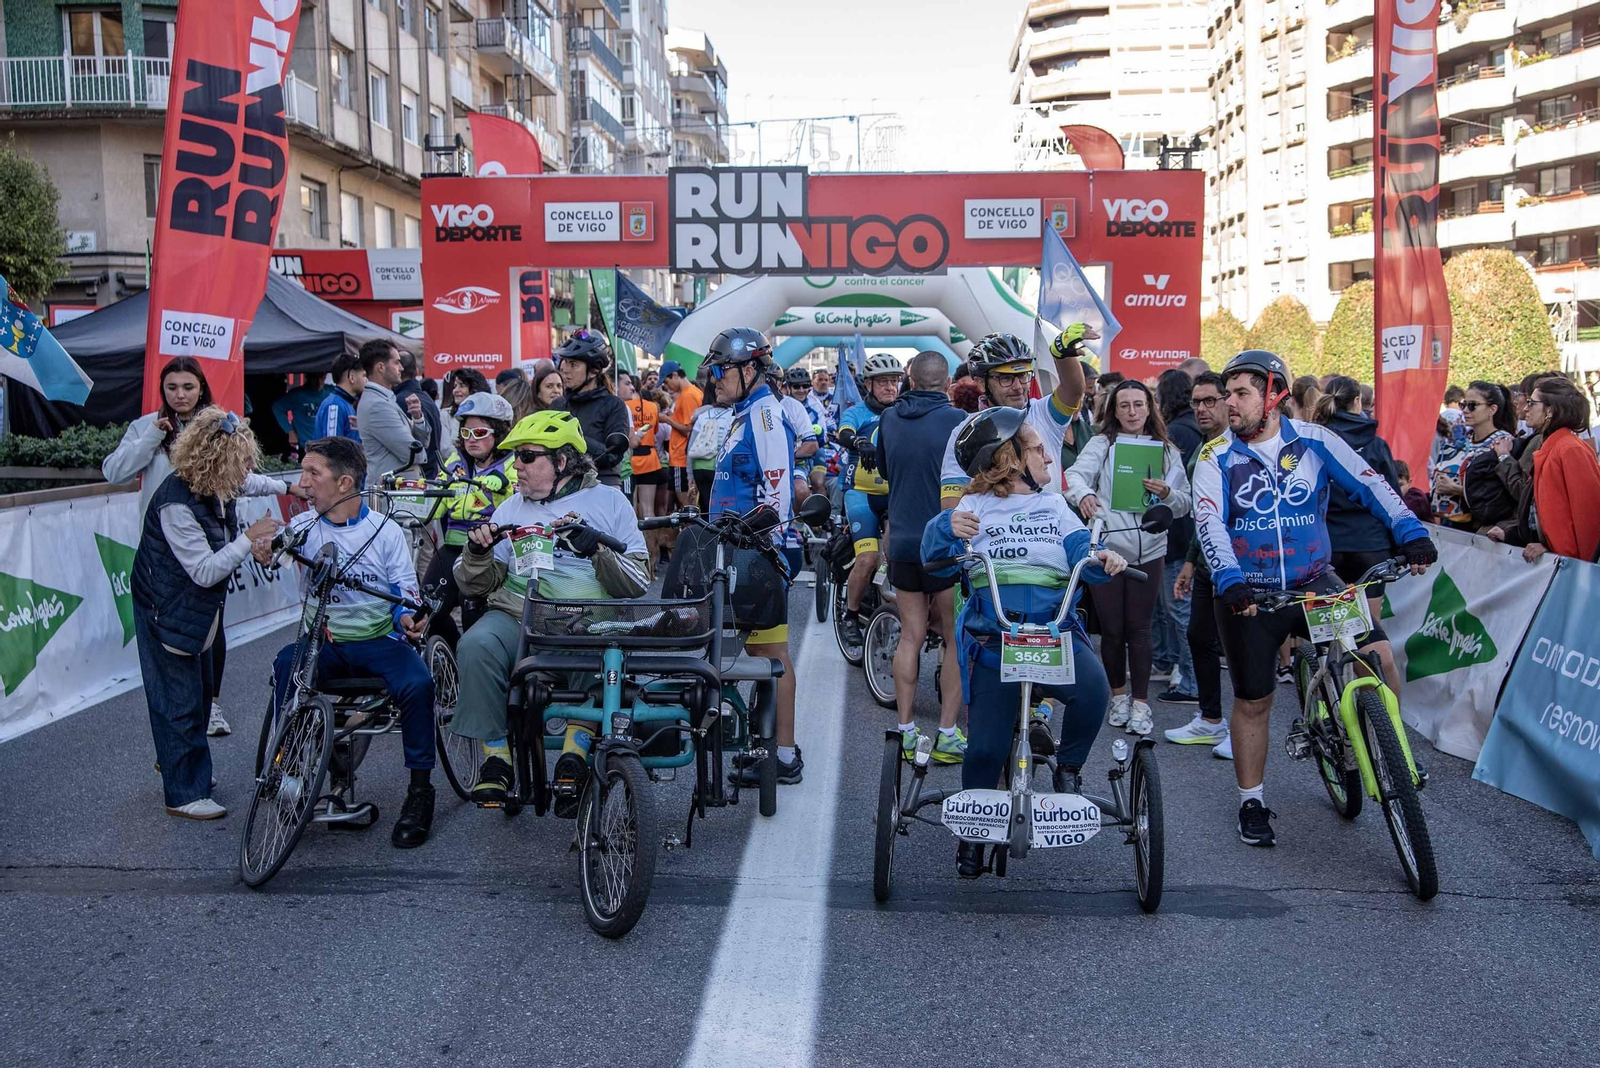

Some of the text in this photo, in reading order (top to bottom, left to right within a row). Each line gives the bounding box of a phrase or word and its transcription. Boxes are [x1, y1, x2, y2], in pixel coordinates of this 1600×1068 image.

[170, 58, 241, 237] RUN
[675, 172, 803, 219] RUN
[430, 204, 494, 227] VIGO
[550, 210, 614, 221] CONCELLO
[970, 206, 1035, 218] CONCELLO
[1102, 199, 1169, 222] VIGO
[558, 222, 607, 233] DE VIGO
[978, 219, 1028, 230] DE VIGO
[1106, 221, 1196, 238] DEPORTE
[435, 225, 522, 242] DEPORTE
[270, 256, 303, 275] UN
[375, 266, 416, 274] CONCELLO
[844, 275, 926, 286] contra el cáncer
[1124, 293, 1188, 307] amura
[814, 311, 826, 324] El
[826, 311, 852, 324] Corte
[854, 309, 892, 327] Inglés
[164, 320, 226, 337] CONCELLO
[171, 334, 216, 349] DE VIGO
[454, 353, 503, 363] HYUNDAI
[1141, 350, 1191, 359] HYUNDAI
[1234, 512, 1315, 531] DisCamino
[985, 526, 1006, 538] En
[521, 540, 544, 553] 2960
[989, 536, 1016, 547] contra
[1199, 521, 1228, 570] turbo
[987, 546, 1028, 559] Vigo
[1014, 651, 1050, 664] 3562
[1531, 636, 1600, 690] OMOD
[1539, 701, 1600, 754] resnov
[946, 798, 1010, 817] turbo10
[1033, 805, 1099, 823] turbo10
[958, 826, 990, 838] VIGO
[1044, 833, 1086, 846] VIGO
